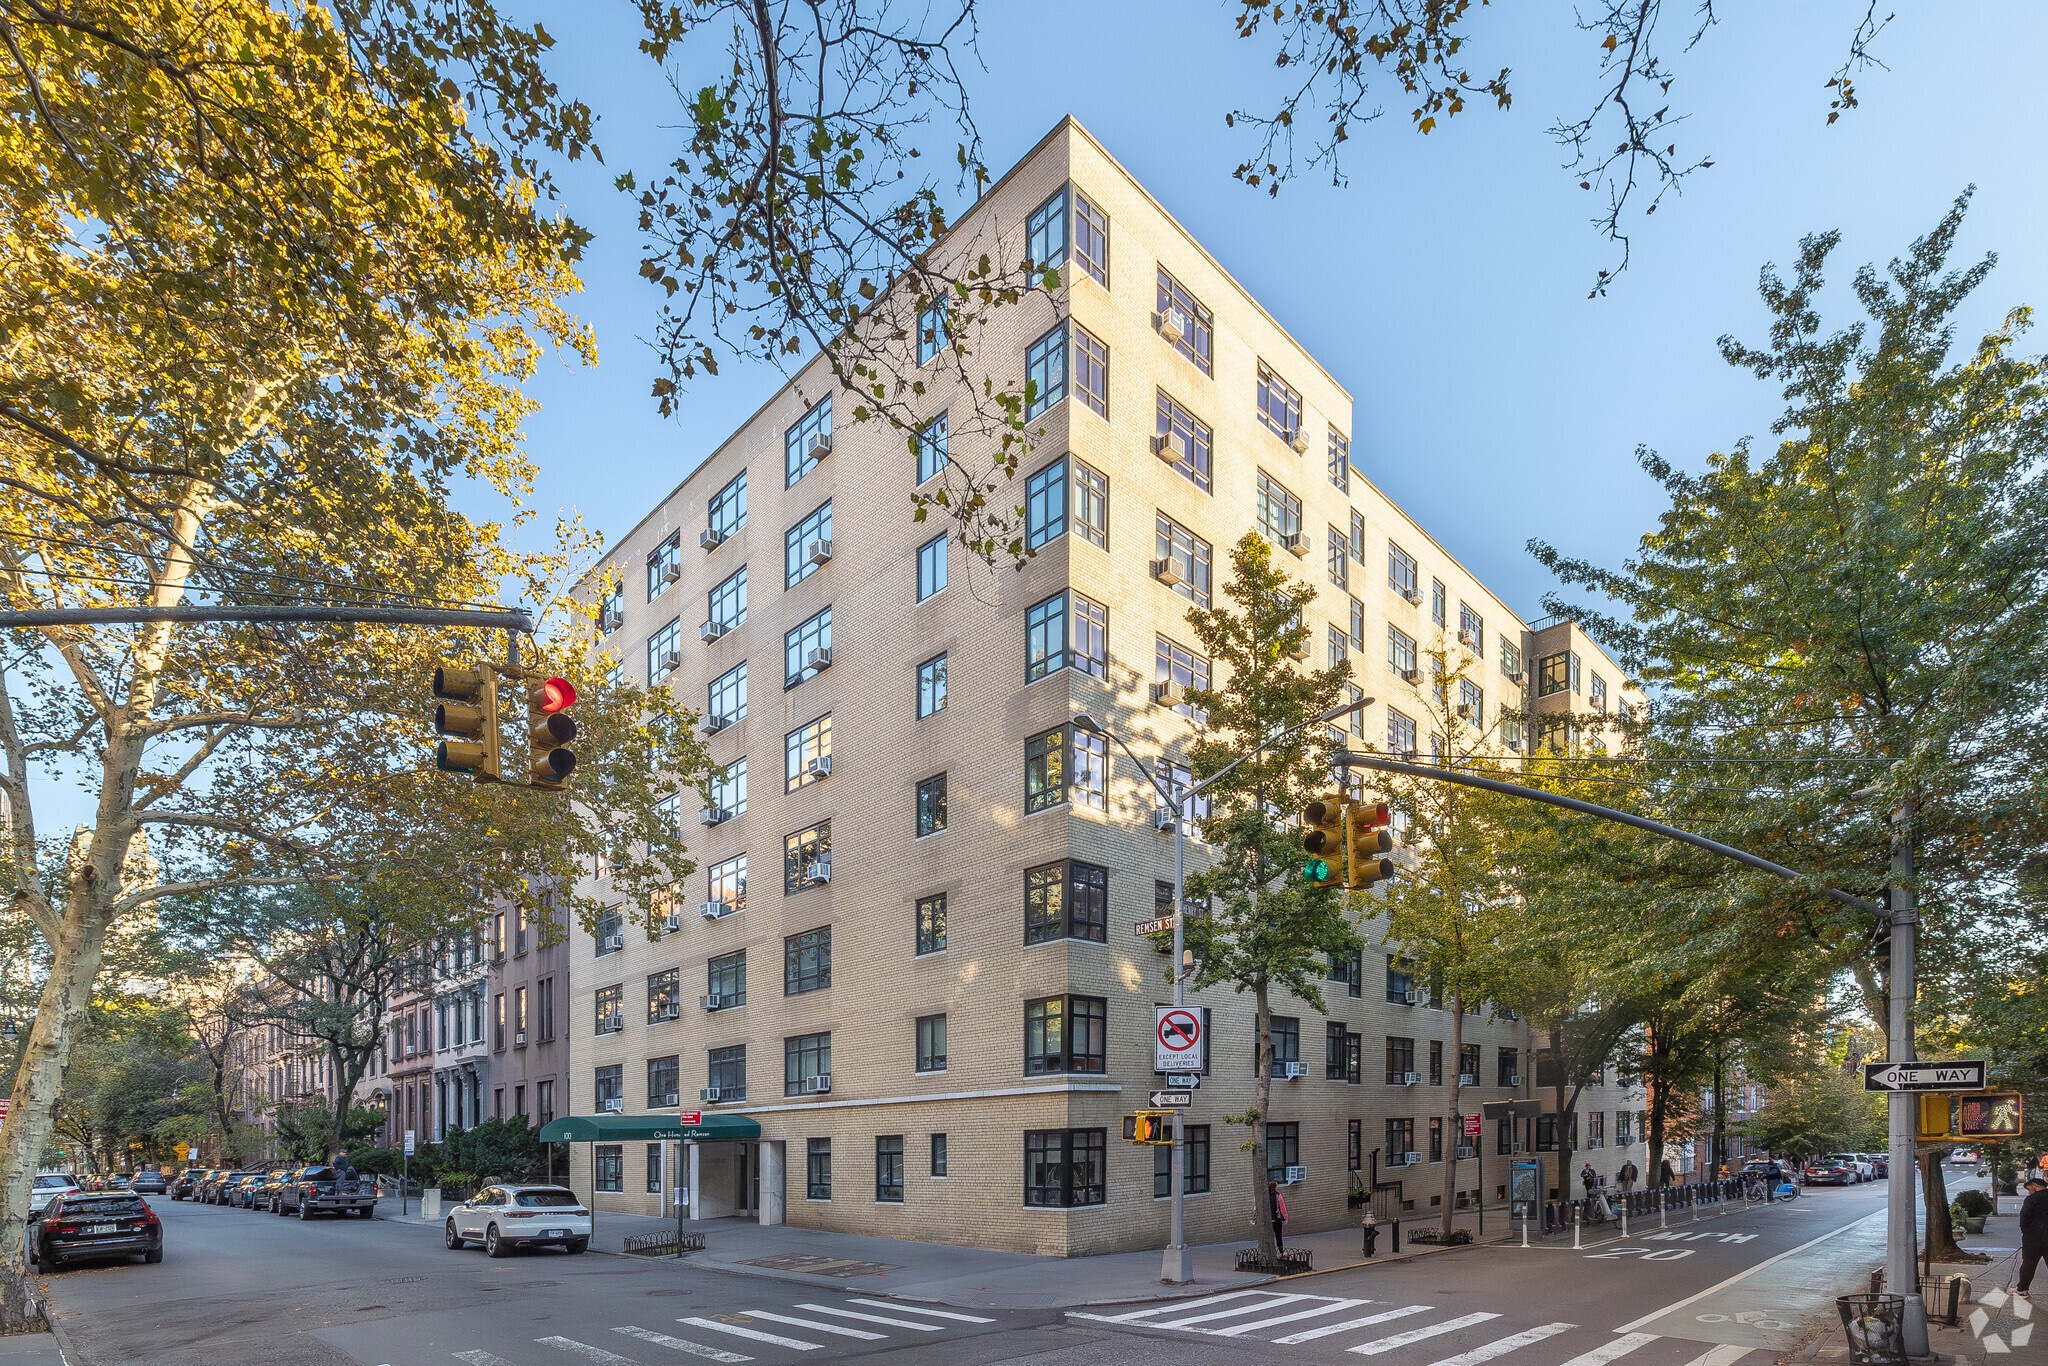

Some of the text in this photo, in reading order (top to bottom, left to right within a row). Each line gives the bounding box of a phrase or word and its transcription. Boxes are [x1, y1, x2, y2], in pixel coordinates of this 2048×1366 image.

[1135, 917, 1174, 936] REMSEN ST
[1169, 1076, 1180, 1084] ONE
[1887, 1069, 1972, 1083] ONE WAY
[1160, 1095, 1188, 1103] ONE WAY
[563, 1132, 572, 1140] 100
[667, 1130, 690, 1138] Huned
[691, 1130, 710, 1138] Remsen
[1640, 1231, 1760, 1244] MPH
[1582, 1247, 1697, 1261] 20
